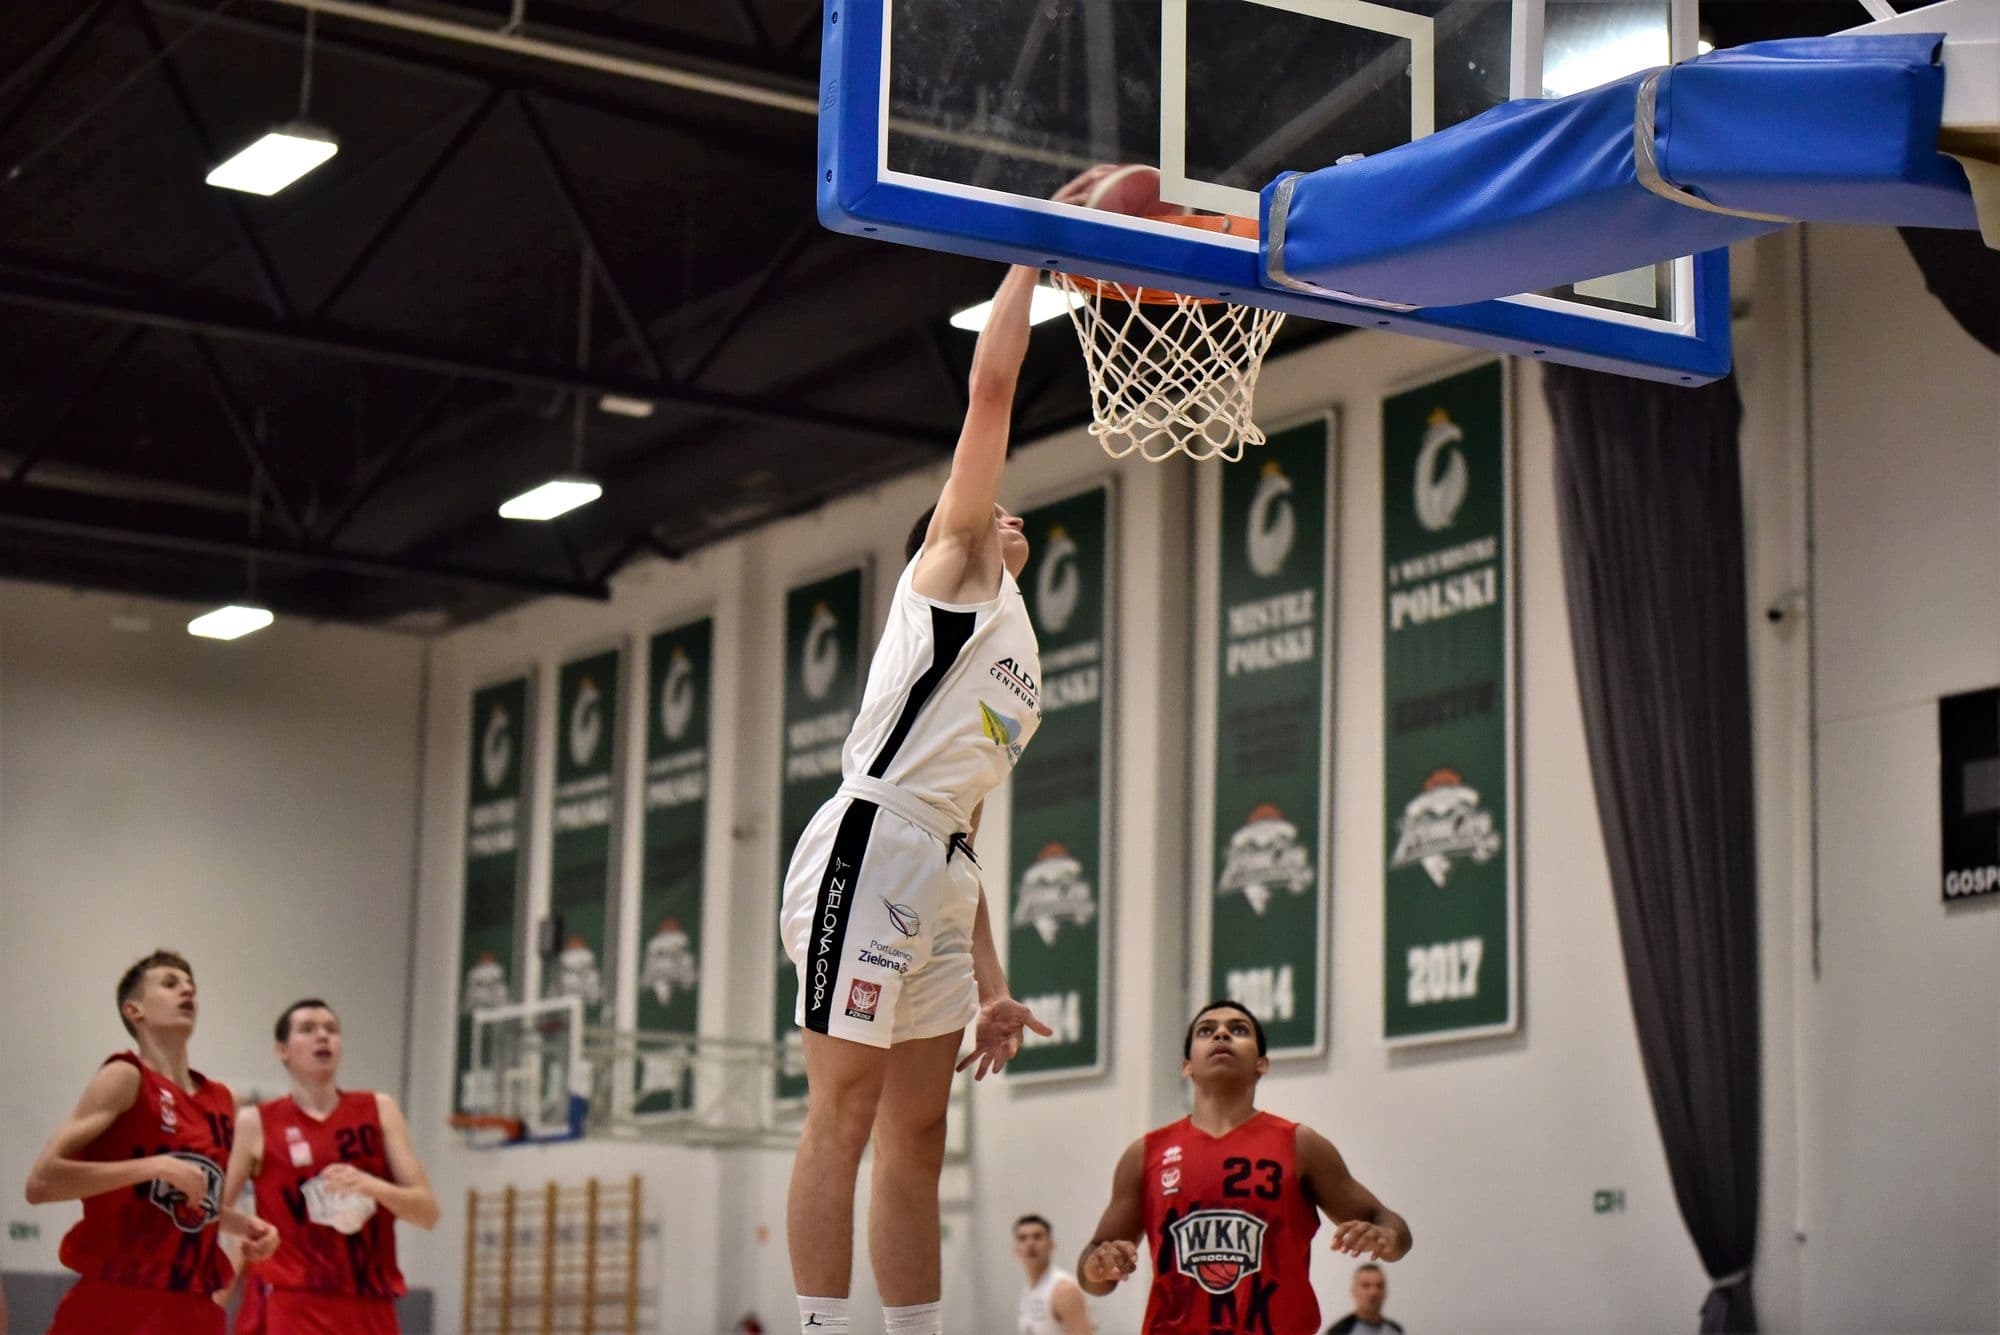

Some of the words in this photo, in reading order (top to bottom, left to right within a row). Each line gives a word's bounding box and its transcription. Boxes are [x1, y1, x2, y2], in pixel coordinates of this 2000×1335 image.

[1391, 566, 1495, 629] POLSKI
[990, 667, 1035, 710] CENTRUM
[1945, 865, 2000, 896] GOSP
[817, 876, 846, 956] ZIELONA
[858, 949, 900, 971] Zielona
[1407, 937, 1483, 1005] 2017
[811, 958, 828, 1011] GÓRA
[335, 1124, 376, 1160] 20
[1222, 1157, 1283, 1200] 23
[1184, 1217, 1252, 1253] WKK
